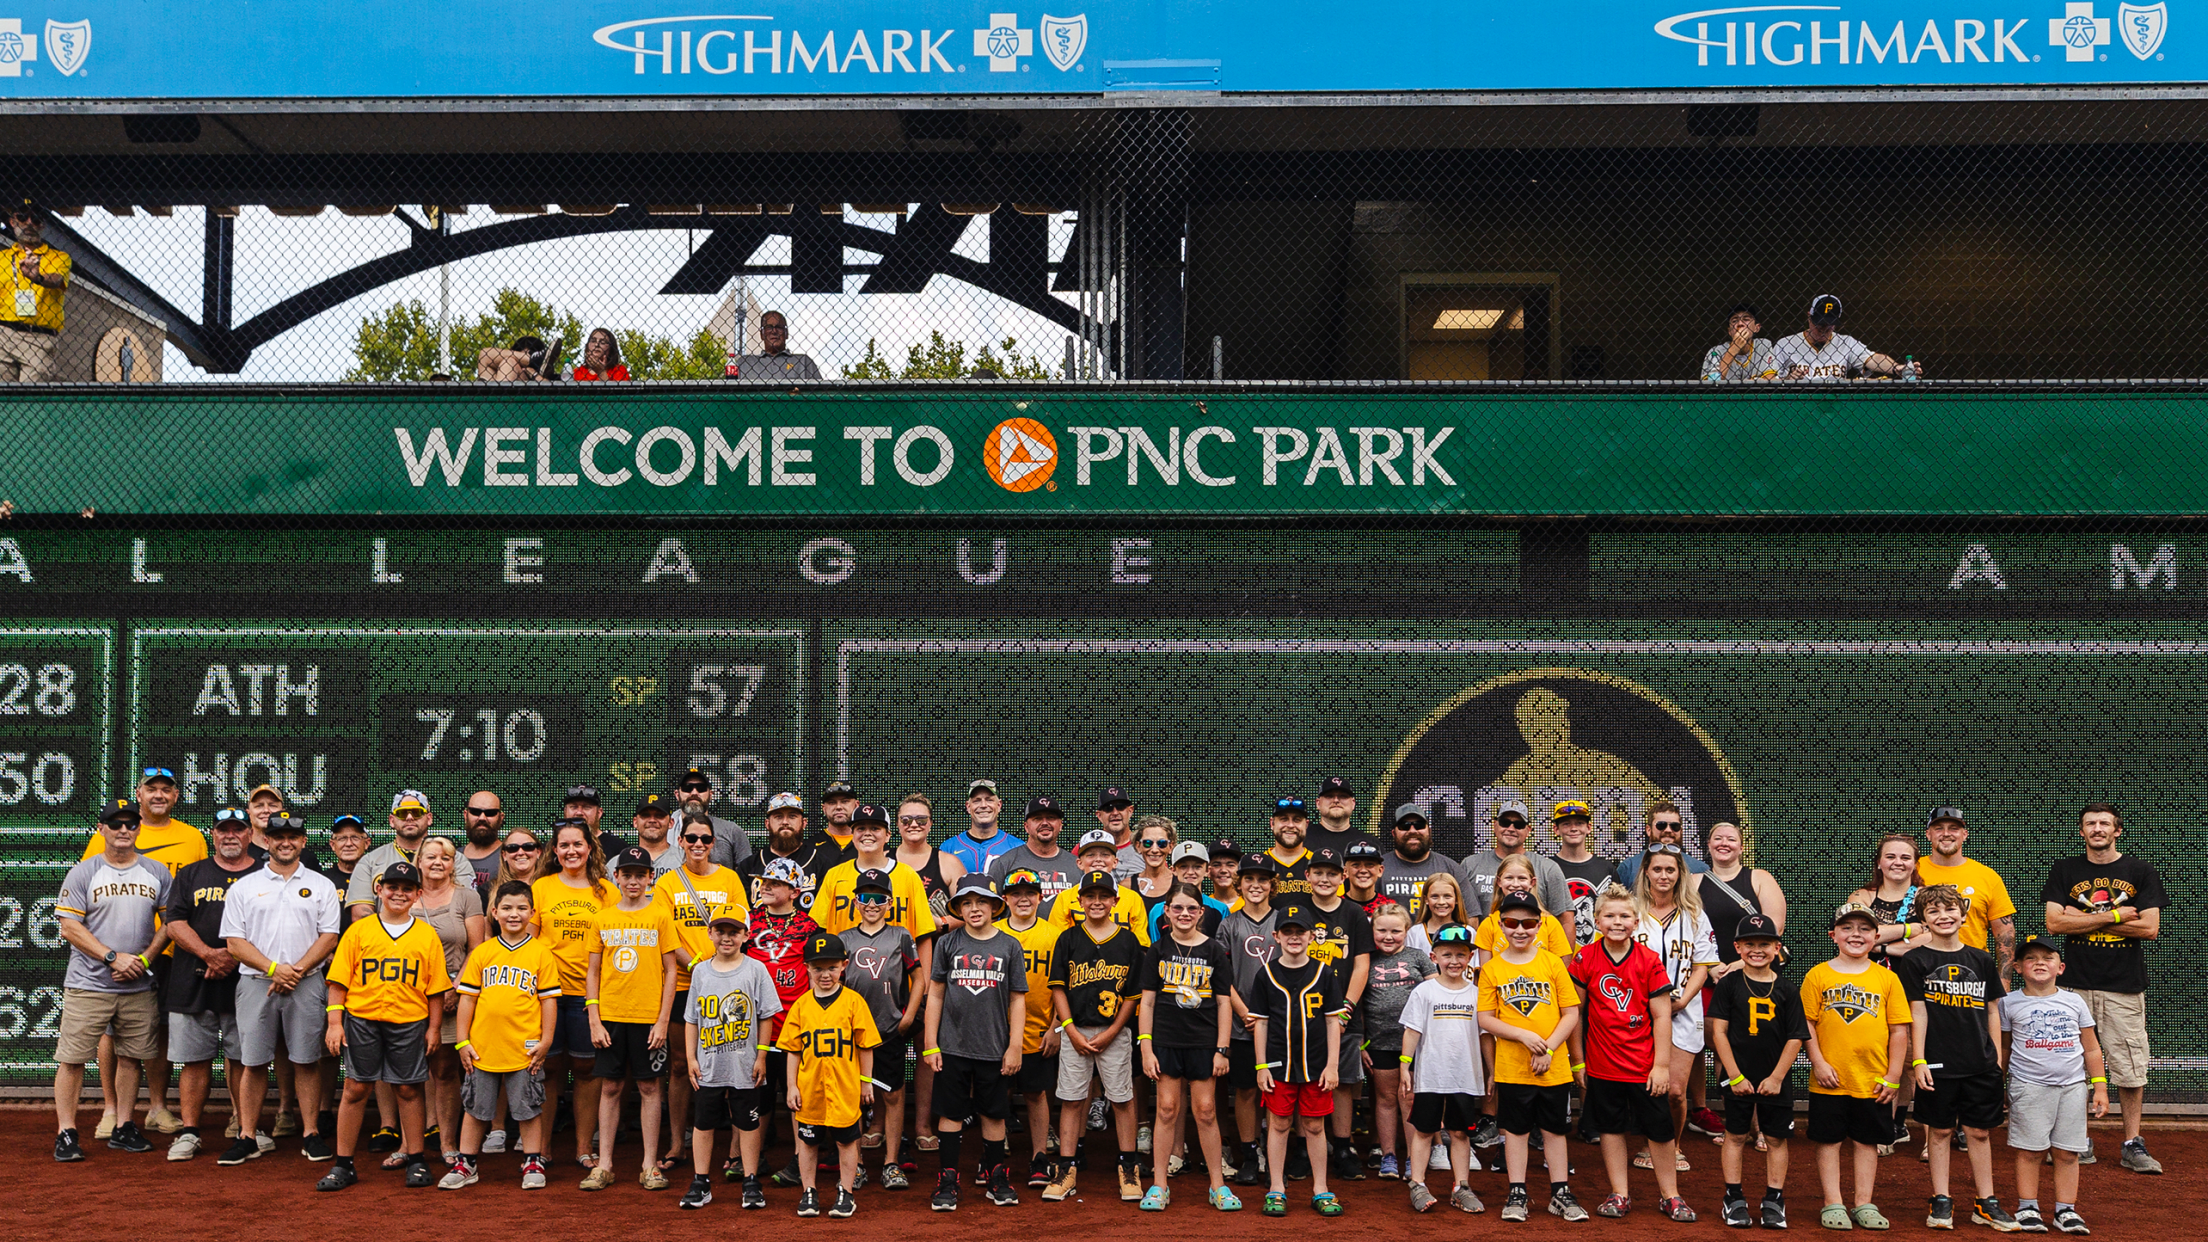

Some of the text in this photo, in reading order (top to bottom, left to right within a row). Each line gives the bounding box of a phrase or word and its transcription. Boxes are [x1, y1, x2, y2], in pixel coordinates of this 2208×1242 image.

[1824, 303, 1833, 314] P
[393, 425, 1458, 487] WELCOME TO PNC PARK
[0, 663, 77, 717] 28
[193, 664, 318, 716] ATH
[611, 676, 658, 706] SP
[687, 665, 766, 717] 57
[416, 708, 547, 761] 7:10
[183, 752, 327, 806] HOU
[608, 761, 657, 792] SP
[117, 799, 128, 809] P
[648, 794, 659, 804] P
[1184, 844, 1193, 853] P
[1092, 872, 1103, 883] P
[1277, 879, 1313, 894] IRATE
[92, 882, 157, 903] PIRATES
[550, 899, 597, 916] PITTSBURG
[722, 905, 733, 915] P
[1288, 906, 1299, 917] P
[562, 929, 585, 941] PGH
[599, 928, 658, 947] PIRATES
[815, 938, 827, 953] P
[1309, 949, 1331, 960] PGH
[619, 950, 632, 968] P
[1023, 949, 1051, 977] GH
[361, 957, 420, 987] PGH
[776, 969, 796, 987] 42
[1948, 966, 1960, 980] P
[1923, 979, 1987, 997] PITTSBURGH
[1306, 992, 1324, 1018] P
[1433, 1003, 1474, 1012] pittsburgh
[1520, 1000, 1530, 1013] P
[1844, 1007, 1854, 1019] P
[1748, 996, 1776, 1034] P
[700, 1019, 751, 1049] SKENES
[800, 1027, 854, 1066] PGH
[2025, 1038, 2075, 1051] Ballgame
